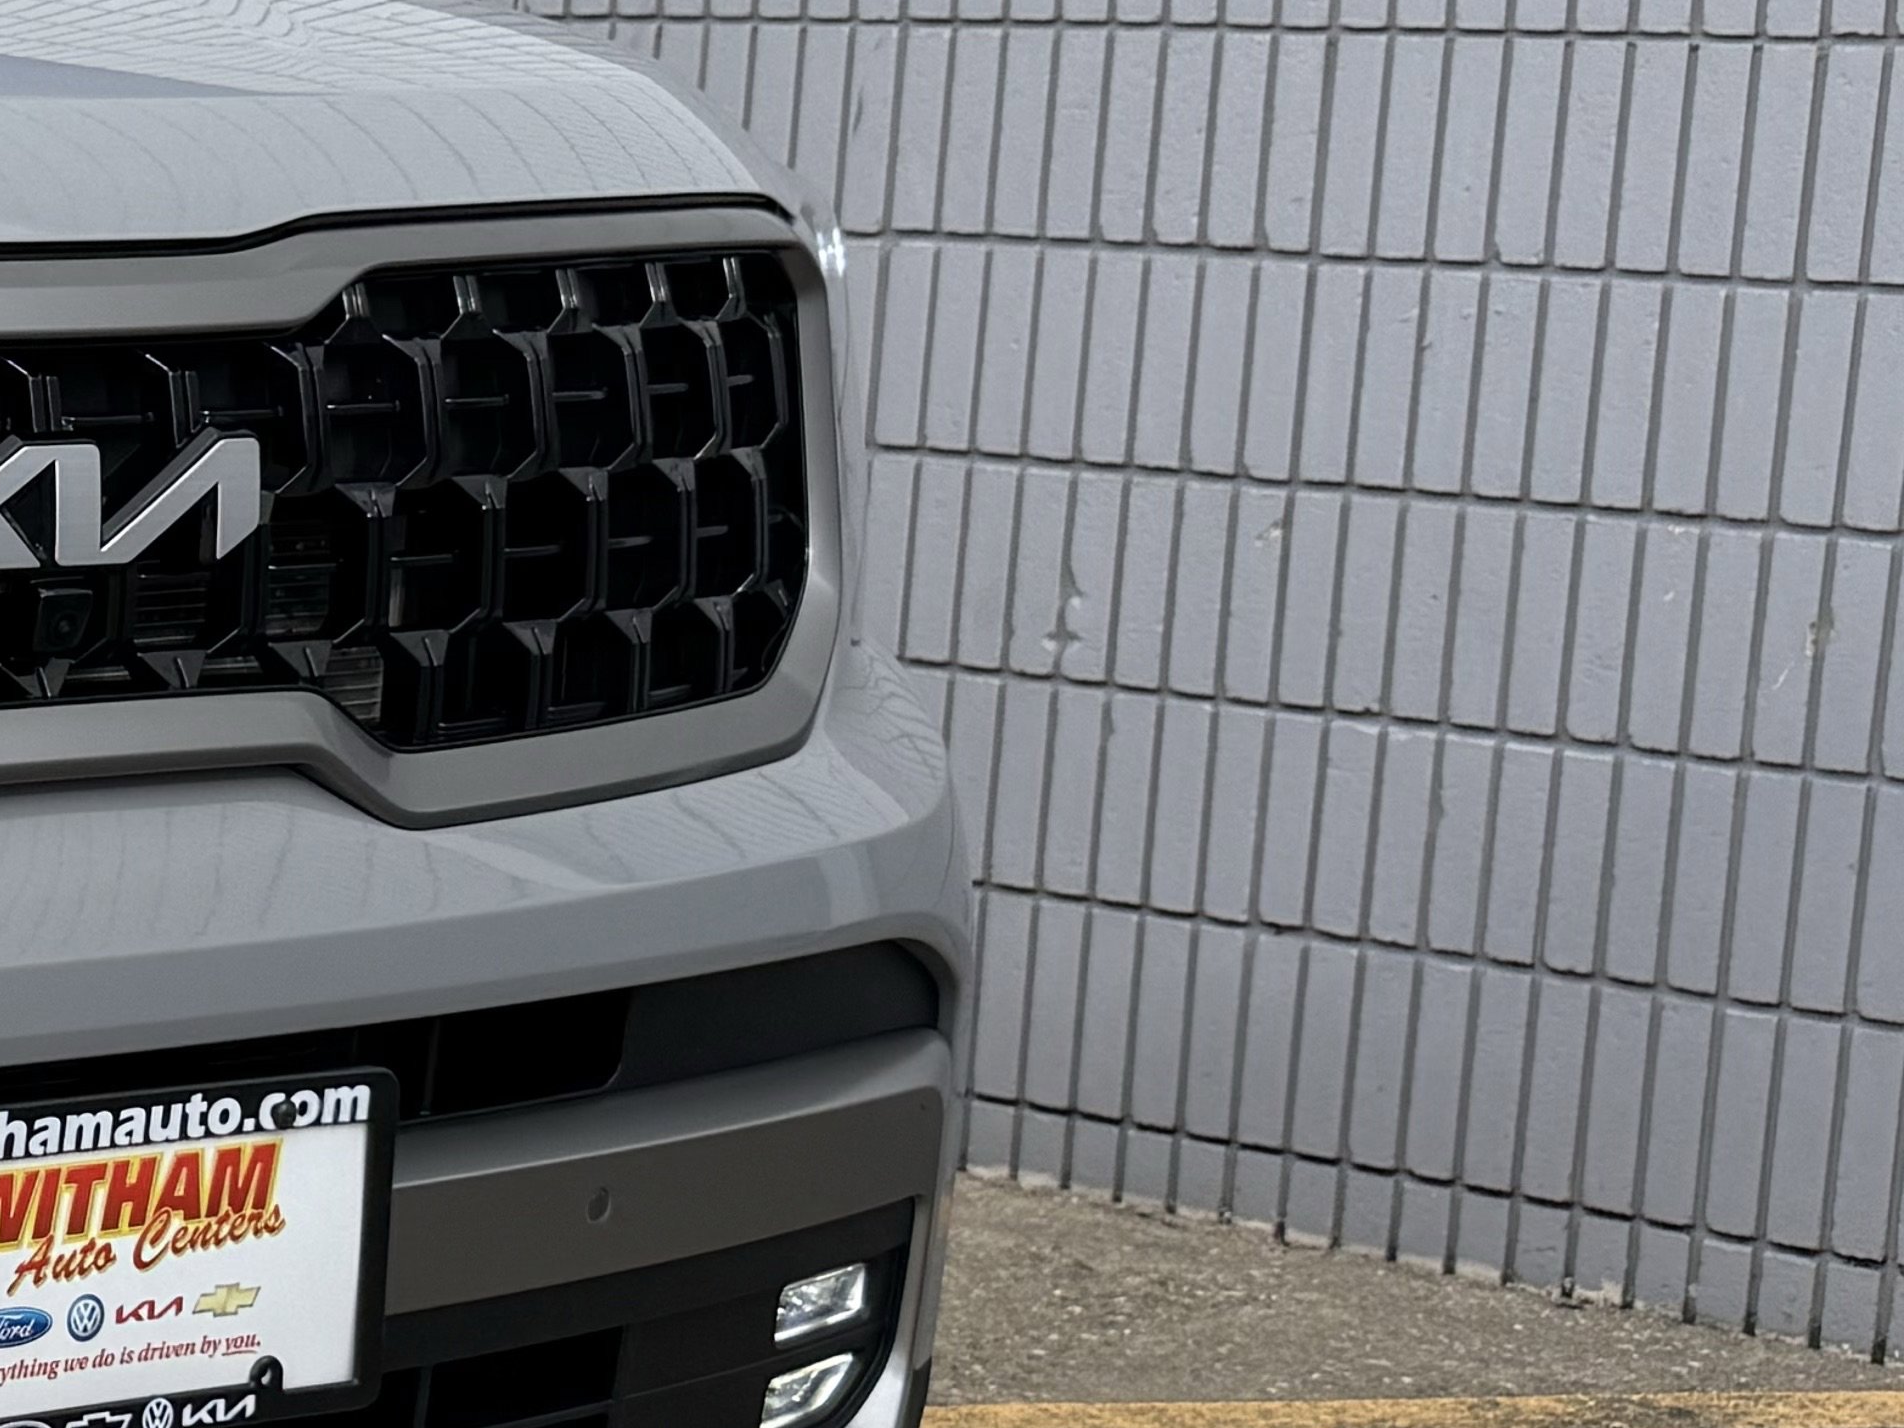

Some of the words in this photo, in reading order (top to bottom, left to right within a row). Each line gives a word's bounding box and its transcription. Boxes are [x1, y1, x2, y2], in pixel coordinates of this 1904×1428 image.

[5, 1235, 117, 1297] Auto
[131, 1203, 287, 1272] Centers
[115, 1296, 184, 1325] KIA
[63, 1356, 90, 1372] we
[93, 1348, 115, 1368] do
[120, 1346, 135, 1365] is
[138, 1339, 195, 1363] driven
[200, 1335, 222, 1358] by
[222, 1334, 261, 1356] you.
[181, 1395, 257, 1427] KIA
